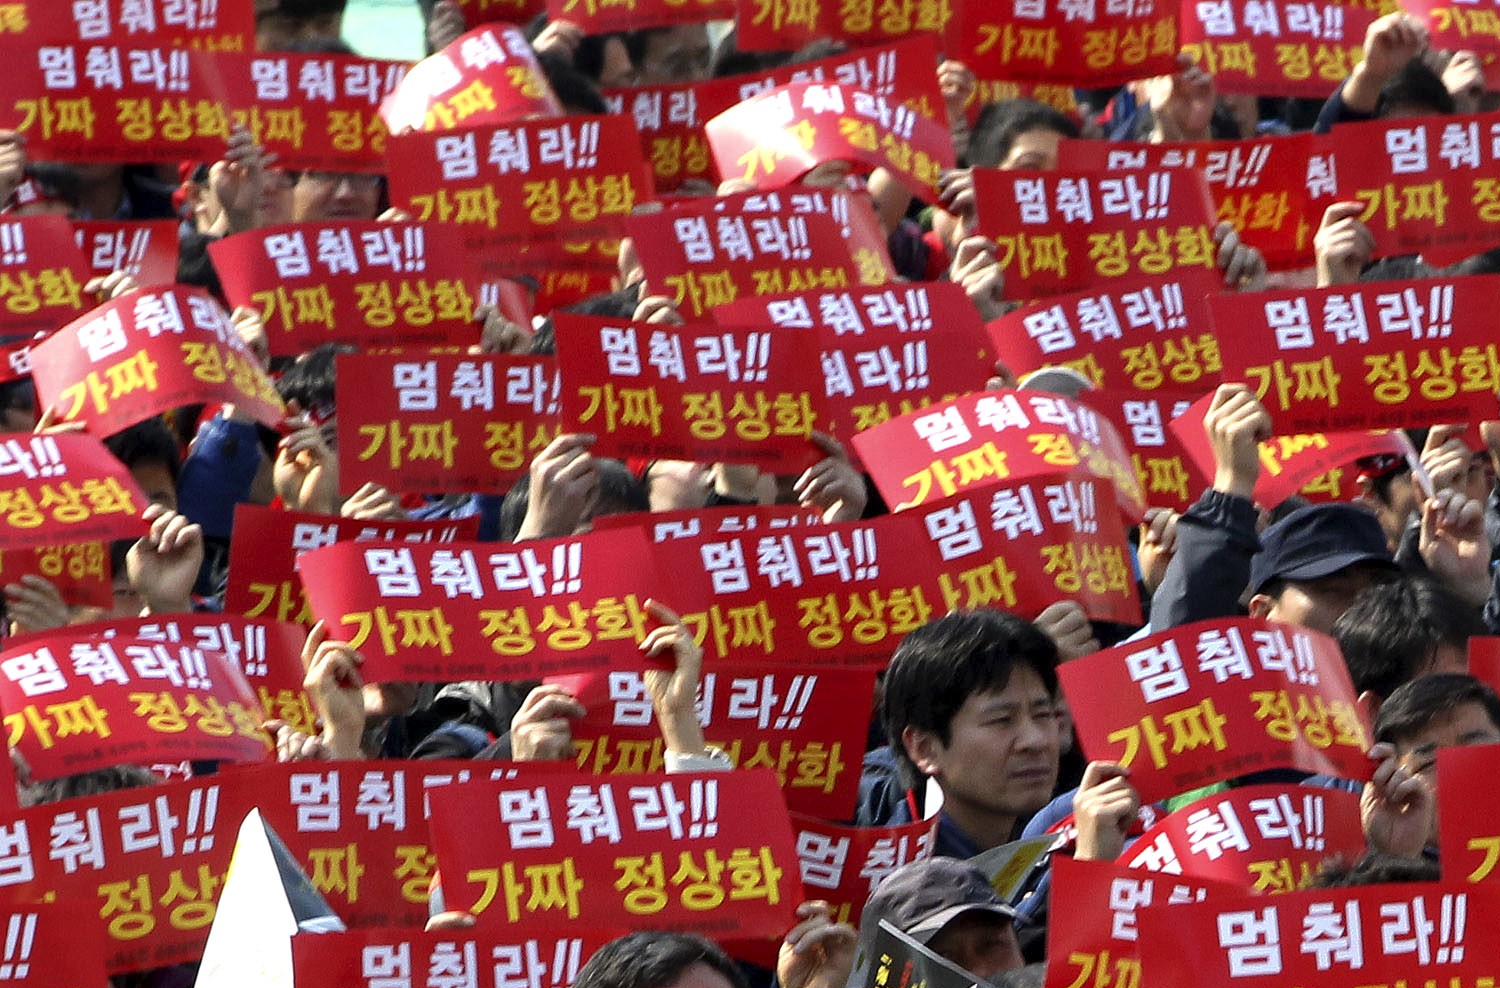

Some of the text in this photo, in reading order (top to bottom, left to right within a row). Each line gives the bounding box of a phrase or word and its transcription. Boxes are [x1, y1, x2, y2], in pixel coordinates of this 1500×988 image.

[16, 98, 94, 138] 가짜
[411, 176, 634, 227] 가짜 정상화
[1357, 181, 1448, 228] 가짜
[998, 226, 1214, 276] 가짜 정상화
[252, 280, 474, 330] 가짜 정상화
[66, 350, 157, 419] 가짜
[1246, 357, 1340, 408] 가짜
[580, 385, 816, 439] 가짜 정상화
[903, 442, 1009, 506] 가짜
[1042, 543, 1127, 594] 정상화
[342, 595, 647, 654] 가짜 정상화
[680, 587, 931, 656] 가짜 정상화
[3, 696, 110, 748] 가짜
[1108, 699, 1226, 768] 가짜
[468, 847, 782, 922] 가짜 정상화
